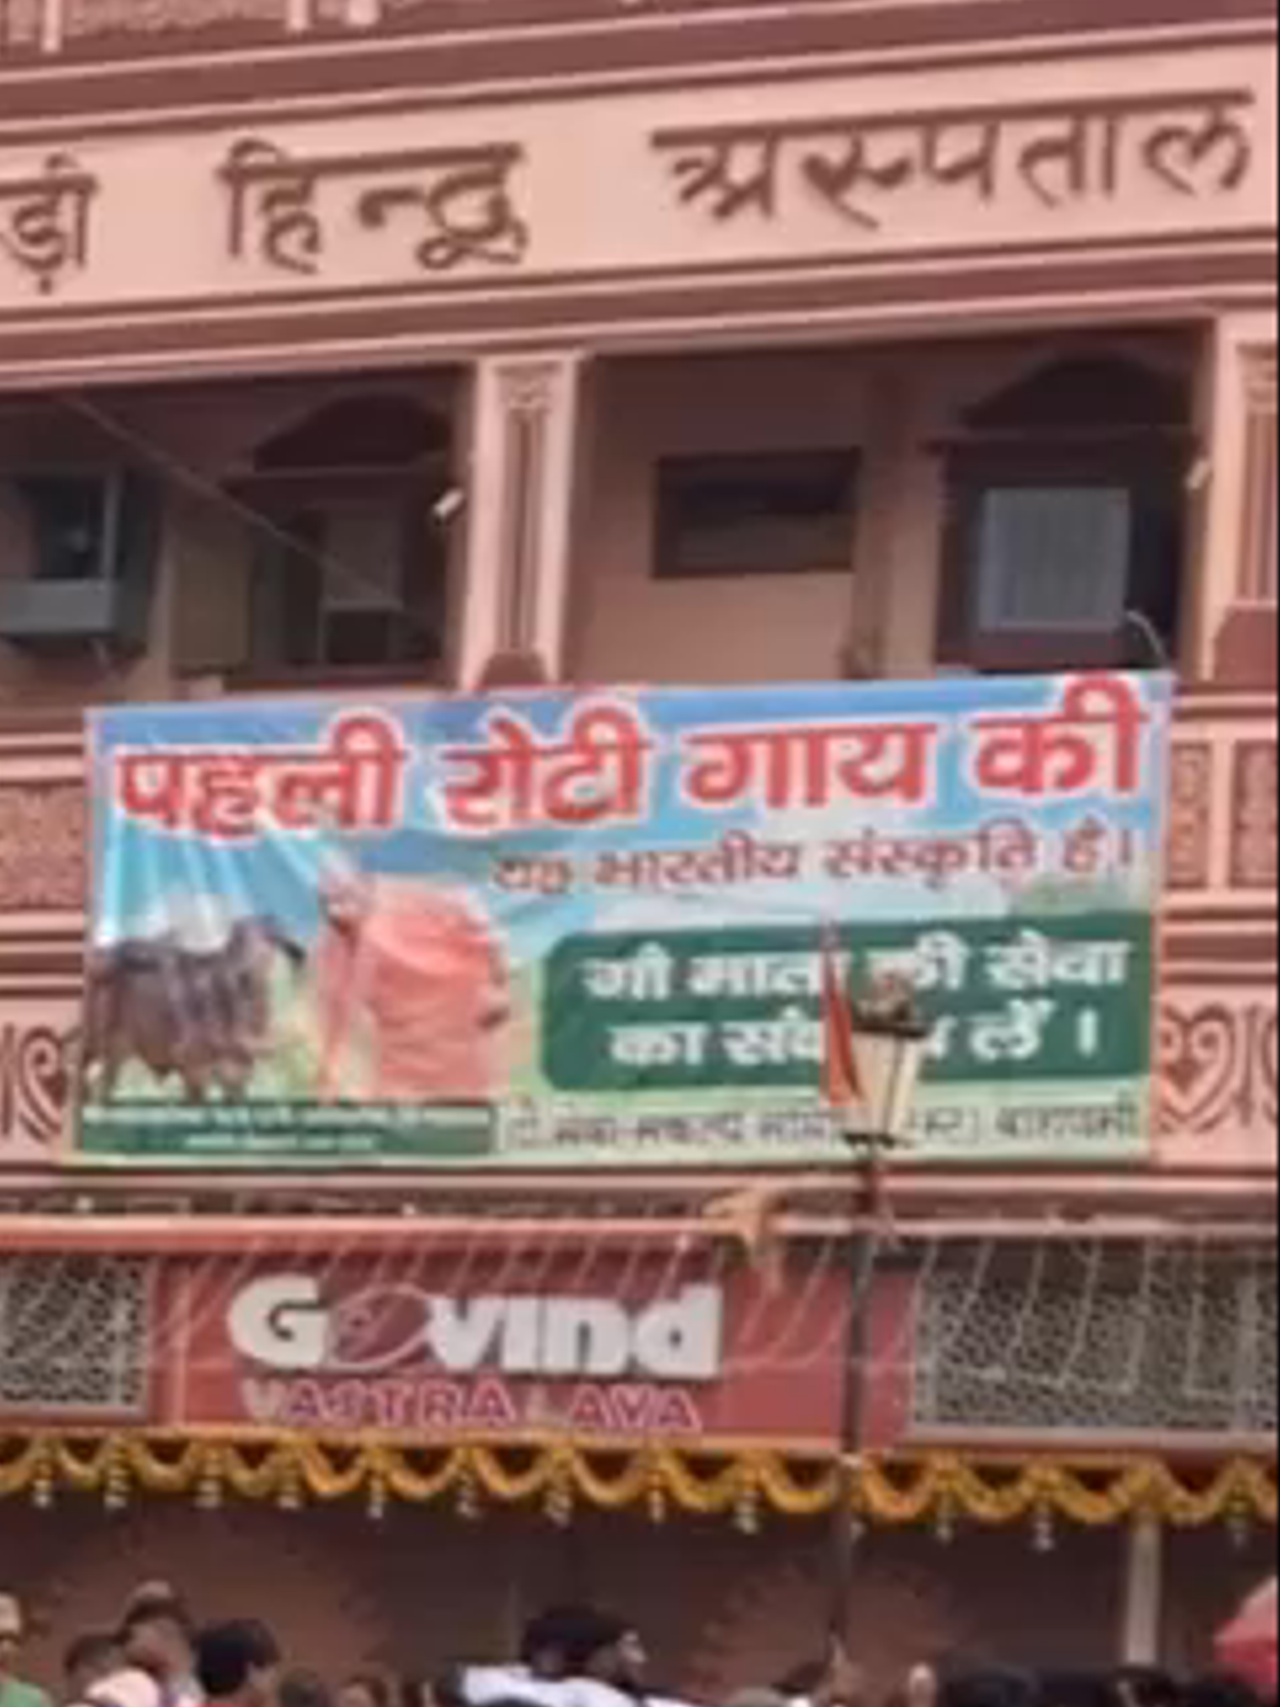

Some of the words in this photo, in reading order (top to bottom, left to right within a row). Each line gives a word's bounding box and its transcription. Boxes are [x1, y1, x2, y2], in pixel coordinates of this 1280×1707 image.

[215, 139, 527, 275] हिन्दू
[648, 88, 1256, 230] अस्पताल
[113, 713, 403, 836] पहली
[439, 705, 644, 826] रोटी
[680, 721, 934, 810] गाय
[968, 677, 1146, 796] की
[492, 849, 574, 895] यह
[595, 829, 802, 893] भारतीय
[820, 815, 1038, 891] संस्कृति
[983, 927, 1132, 990] सेवा
[608, 1021, 709, 1065] का
[226, 1272, 723, 1380] Govind
